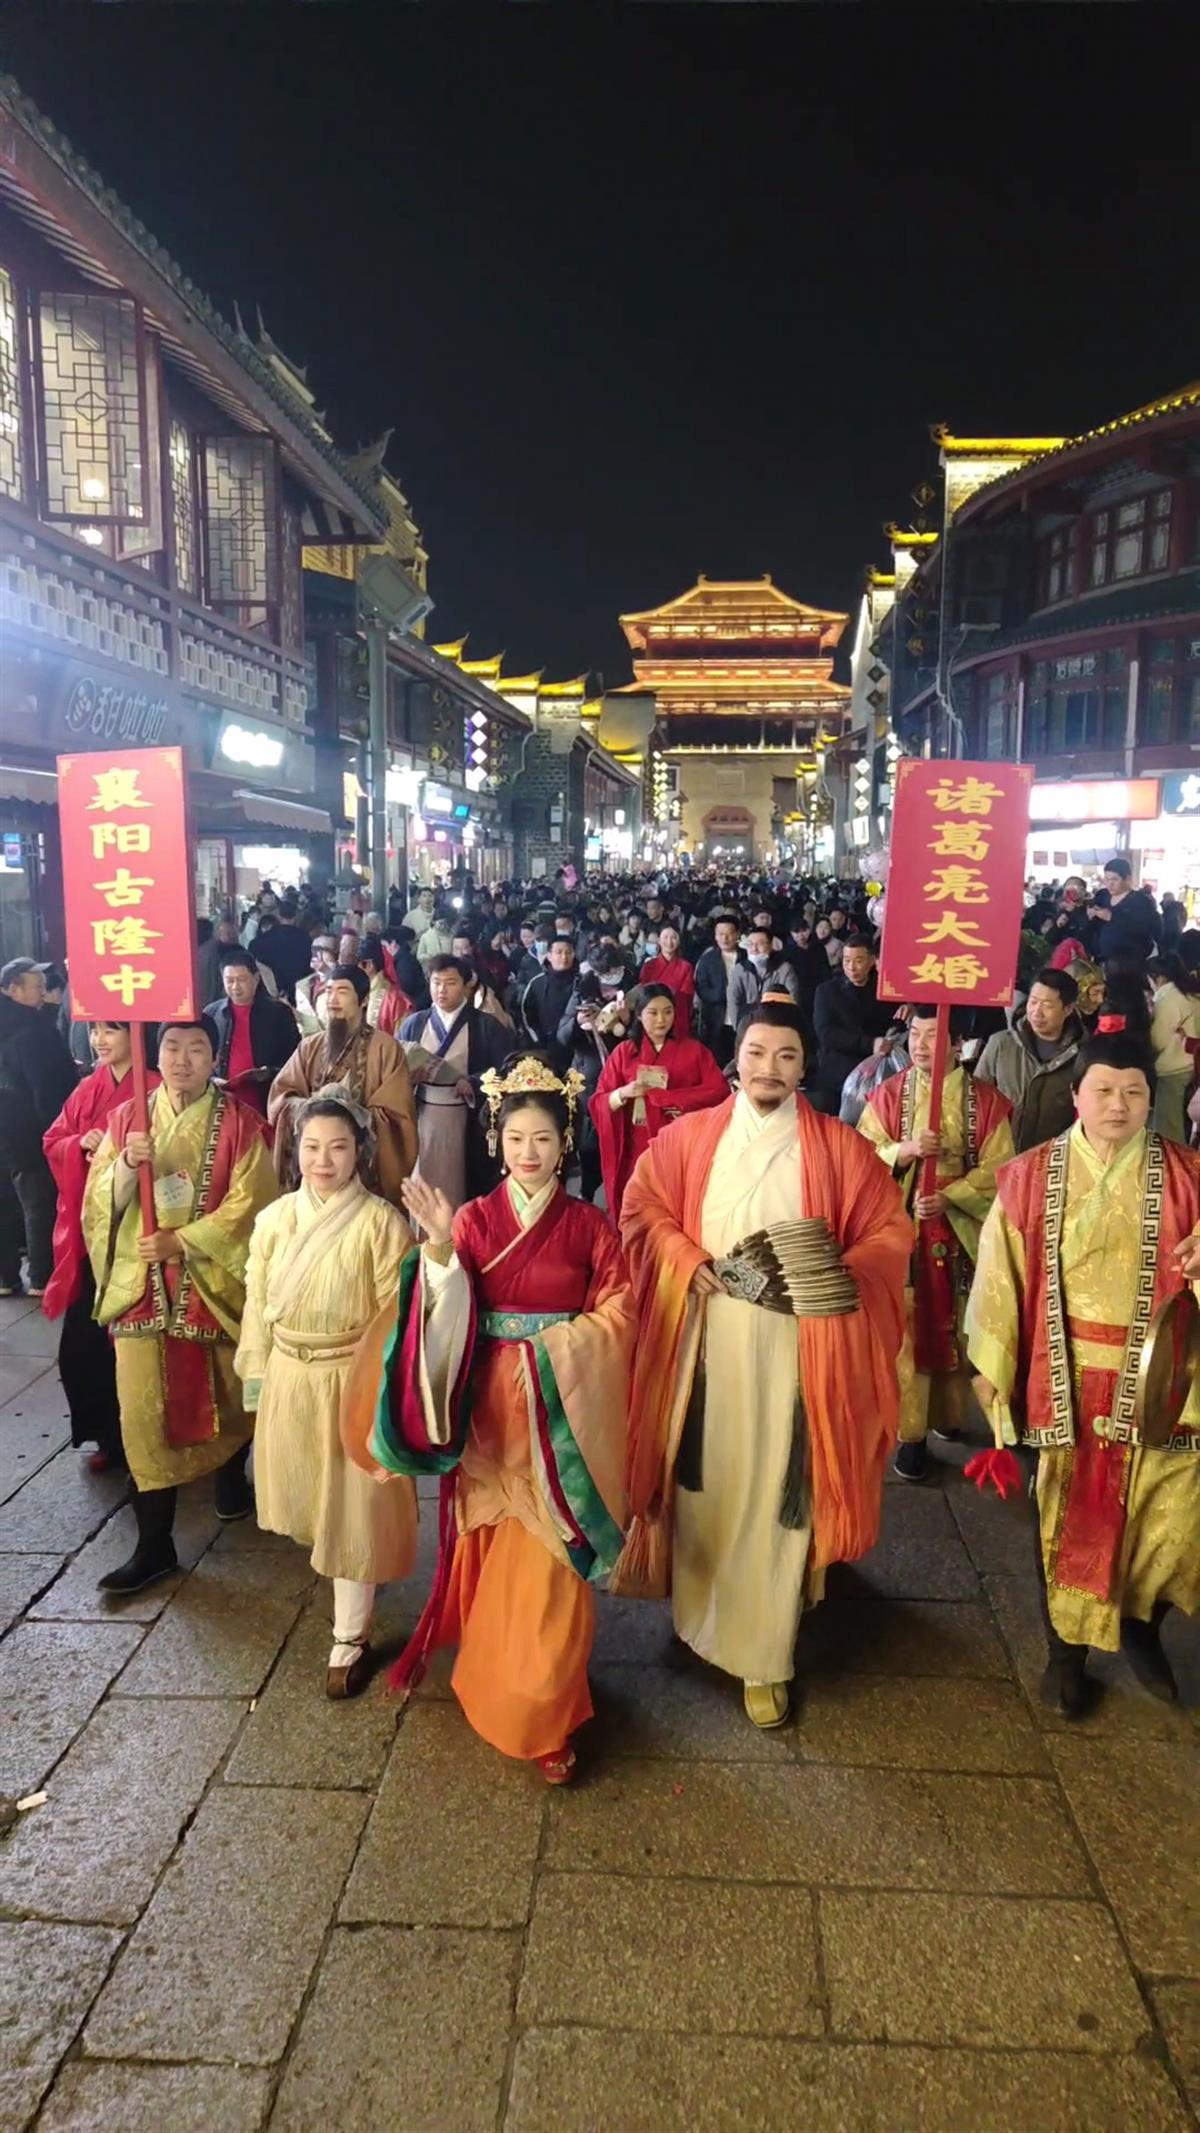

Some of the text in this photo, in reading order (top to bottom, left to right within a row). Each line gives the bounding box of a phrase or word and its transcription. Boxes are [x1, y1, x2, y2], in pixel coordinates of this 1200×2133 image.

[86, 767, 163, 1006] 襄阳古隆中
[909, 778, 1004, 990] 诸葛亮大婚
